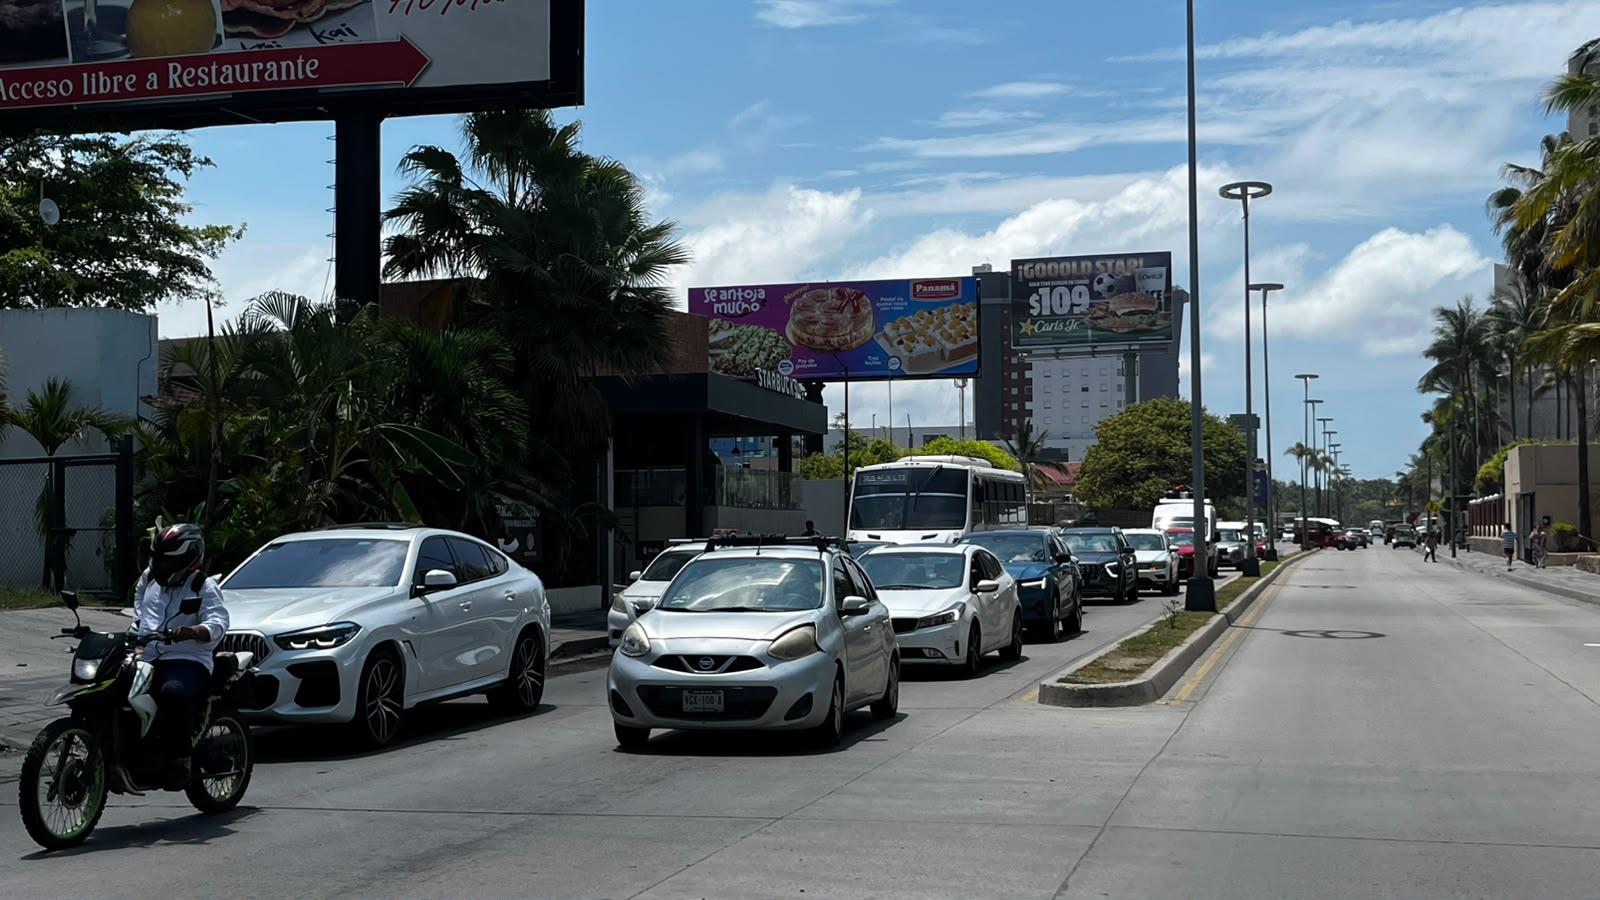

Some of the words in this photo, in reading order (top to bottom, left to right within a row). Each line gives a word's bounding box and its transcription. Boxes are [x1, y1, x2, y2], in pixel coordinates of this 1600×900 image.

[81, 71, 137, 96] libre
[146, 72, 159, 91] a
[167, 54, 320, 89] Restaurante
[703, 288, 718, 303] Se
[720, 287, 766, 303] antoja
[916, 282, 956, 293] Panamá
[714, 301, 760, 314] mucho
[1029, 285, 1090, 316] $109
[756, 367, 806, 400] STARBUCKS
